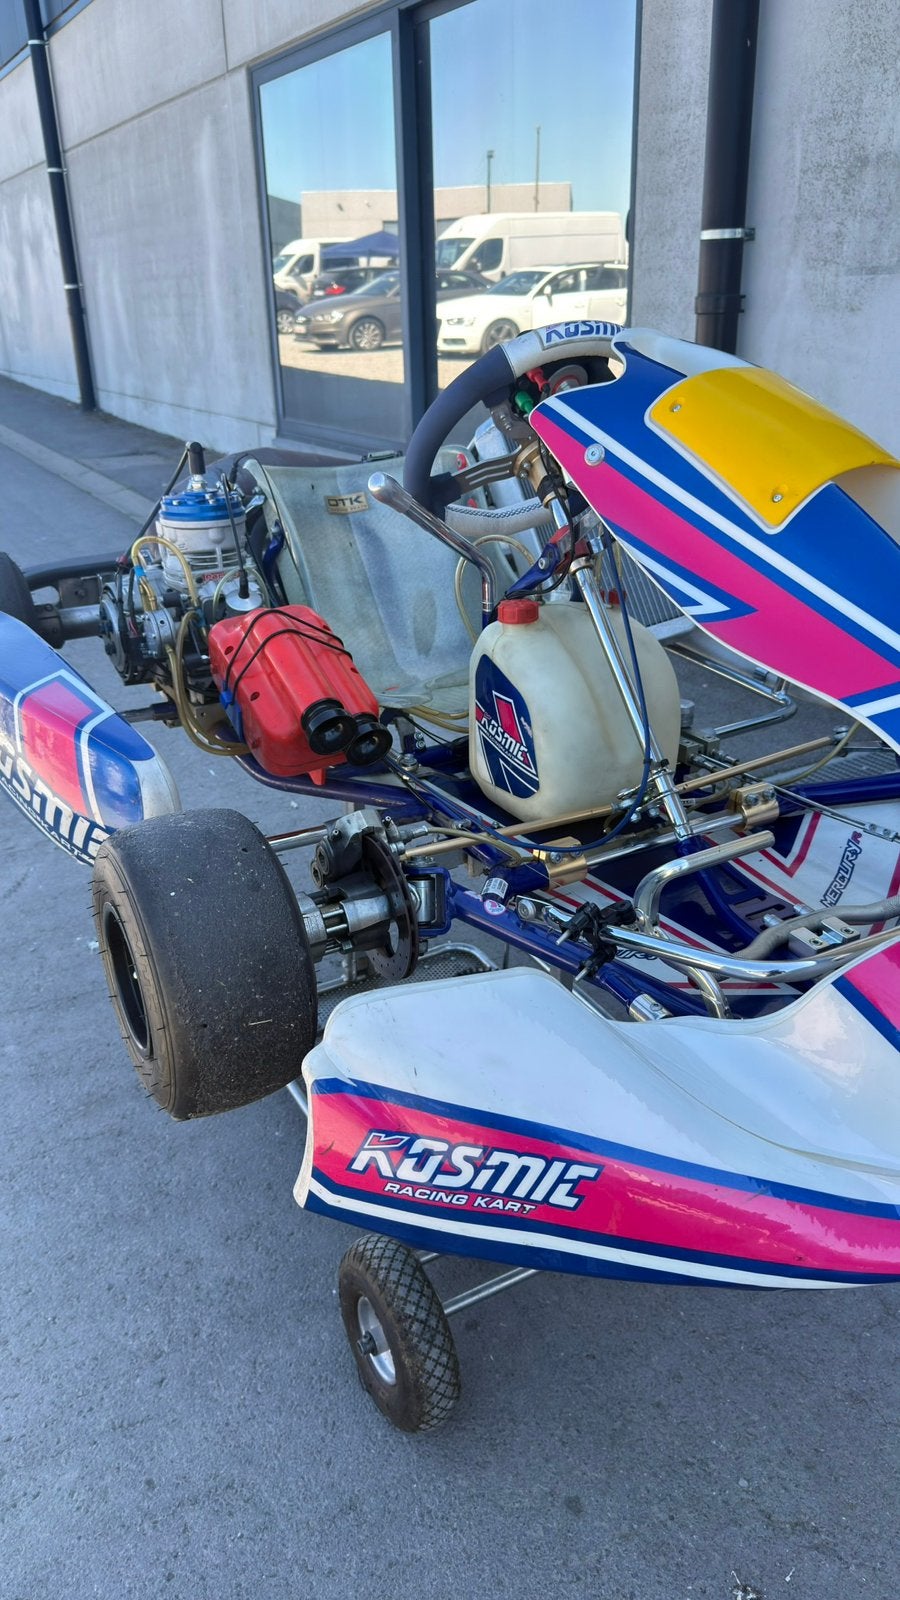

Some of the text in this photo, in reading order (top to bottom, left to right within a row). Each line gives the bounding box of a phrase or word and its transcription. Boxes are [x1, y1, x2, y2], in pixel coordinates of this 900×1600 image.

[327, 496, 363, 507] OTK
[481, 711, 528, 761] KOSMIC
[0, 731, 111, 858] OSMIC
[349, 1131, 600, 1209] KOSMIC
[384, 1181, 537, 1215] RACING KART
